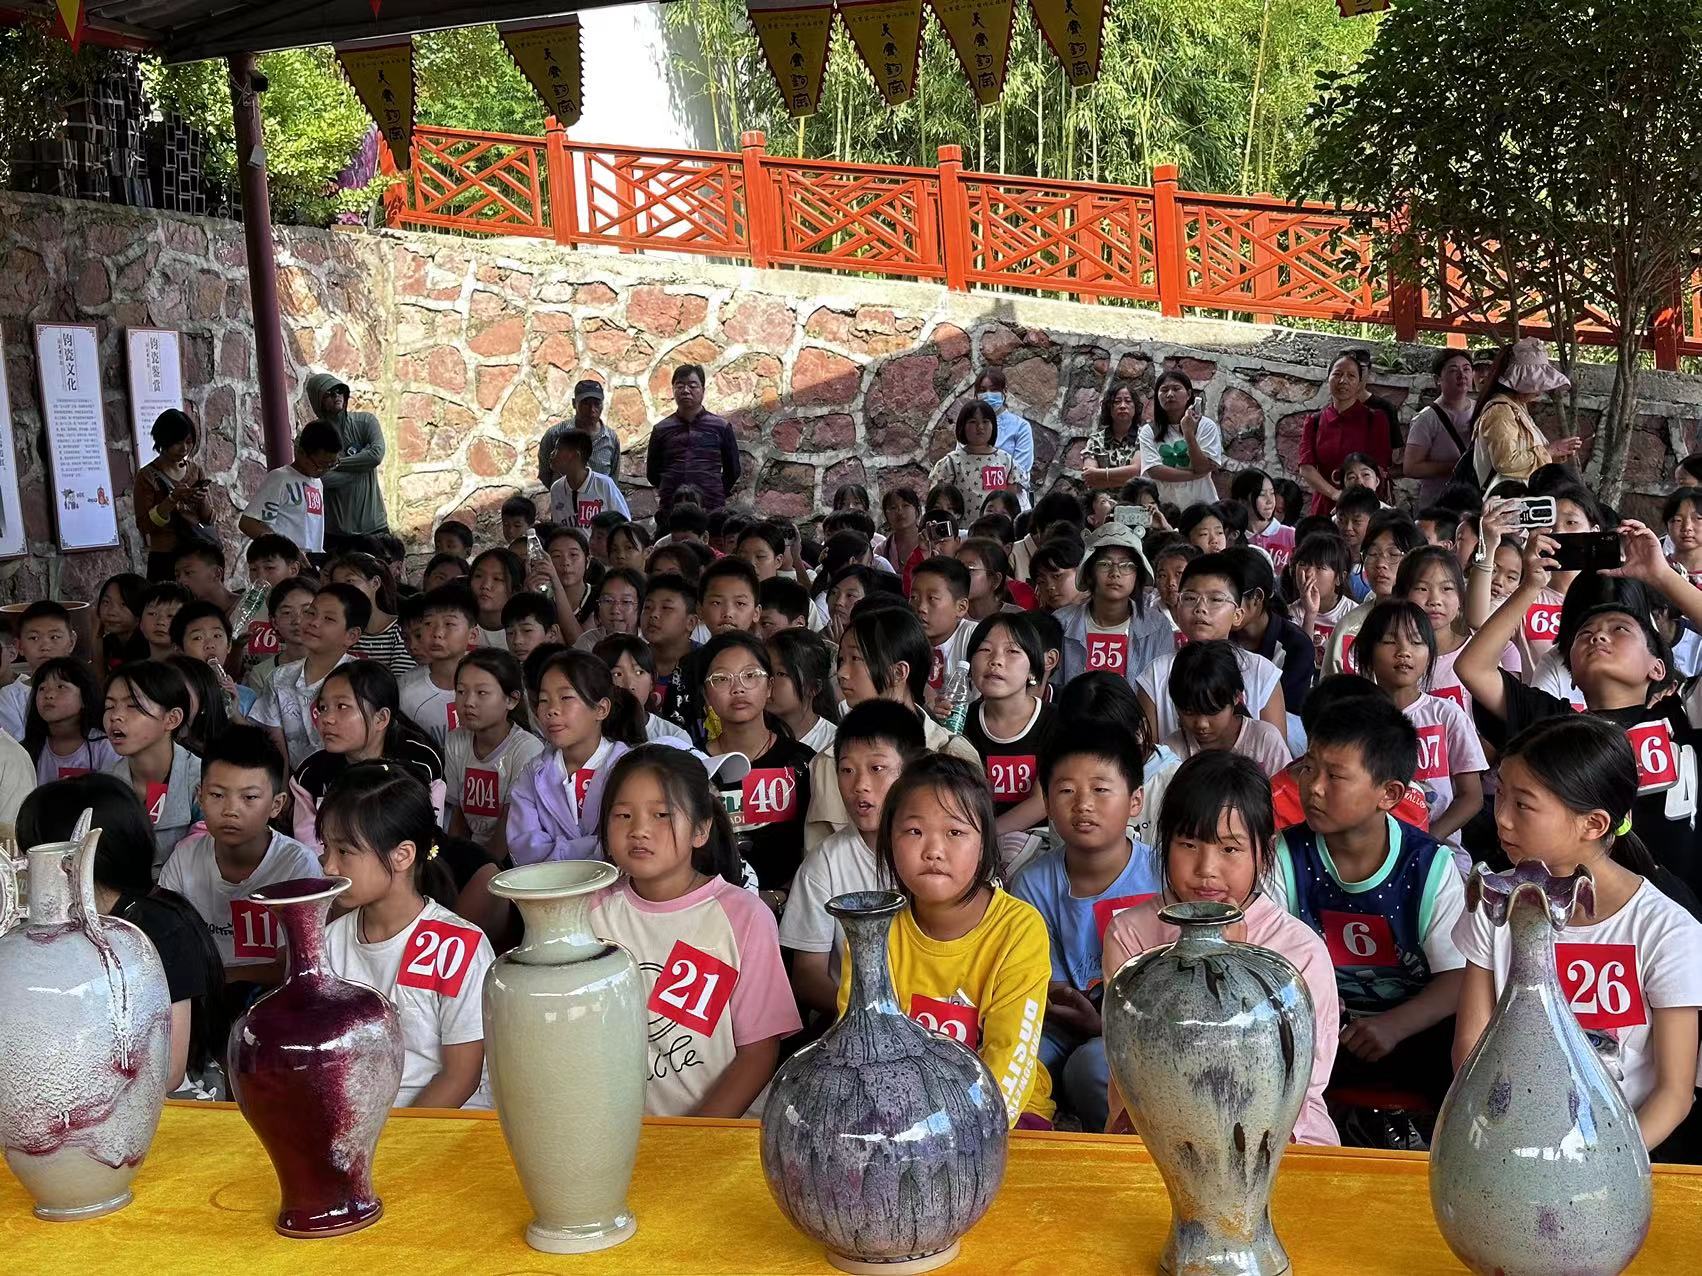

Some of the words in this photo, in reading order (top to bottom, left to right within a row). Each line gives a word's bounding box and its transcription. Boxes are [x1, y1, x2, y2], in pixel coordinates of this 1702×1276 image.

[62, 333, 77, 391] 钧瓷文化
[985, 470, 1004, 487] 178
[306, 491, 321, 510] 139
[1530, 610, 1562, 635] 68
[1090, 641, 1123, 668] 55
[1417, 735, 1440, 770] 07
[1639, 735, 1668, 774] 6
[466, 776, 496, 809] 204
[748, 777, 791, 813] 40
[991, 763, 1032, 794] 213
[241, 910, 276, 949] 11
[1342, 921, 1377, 957] 6
[406, 930, 466, 980] 20
[658, 959, 720, 1022] 21
[1567, 959, 1631, 1015] 26
